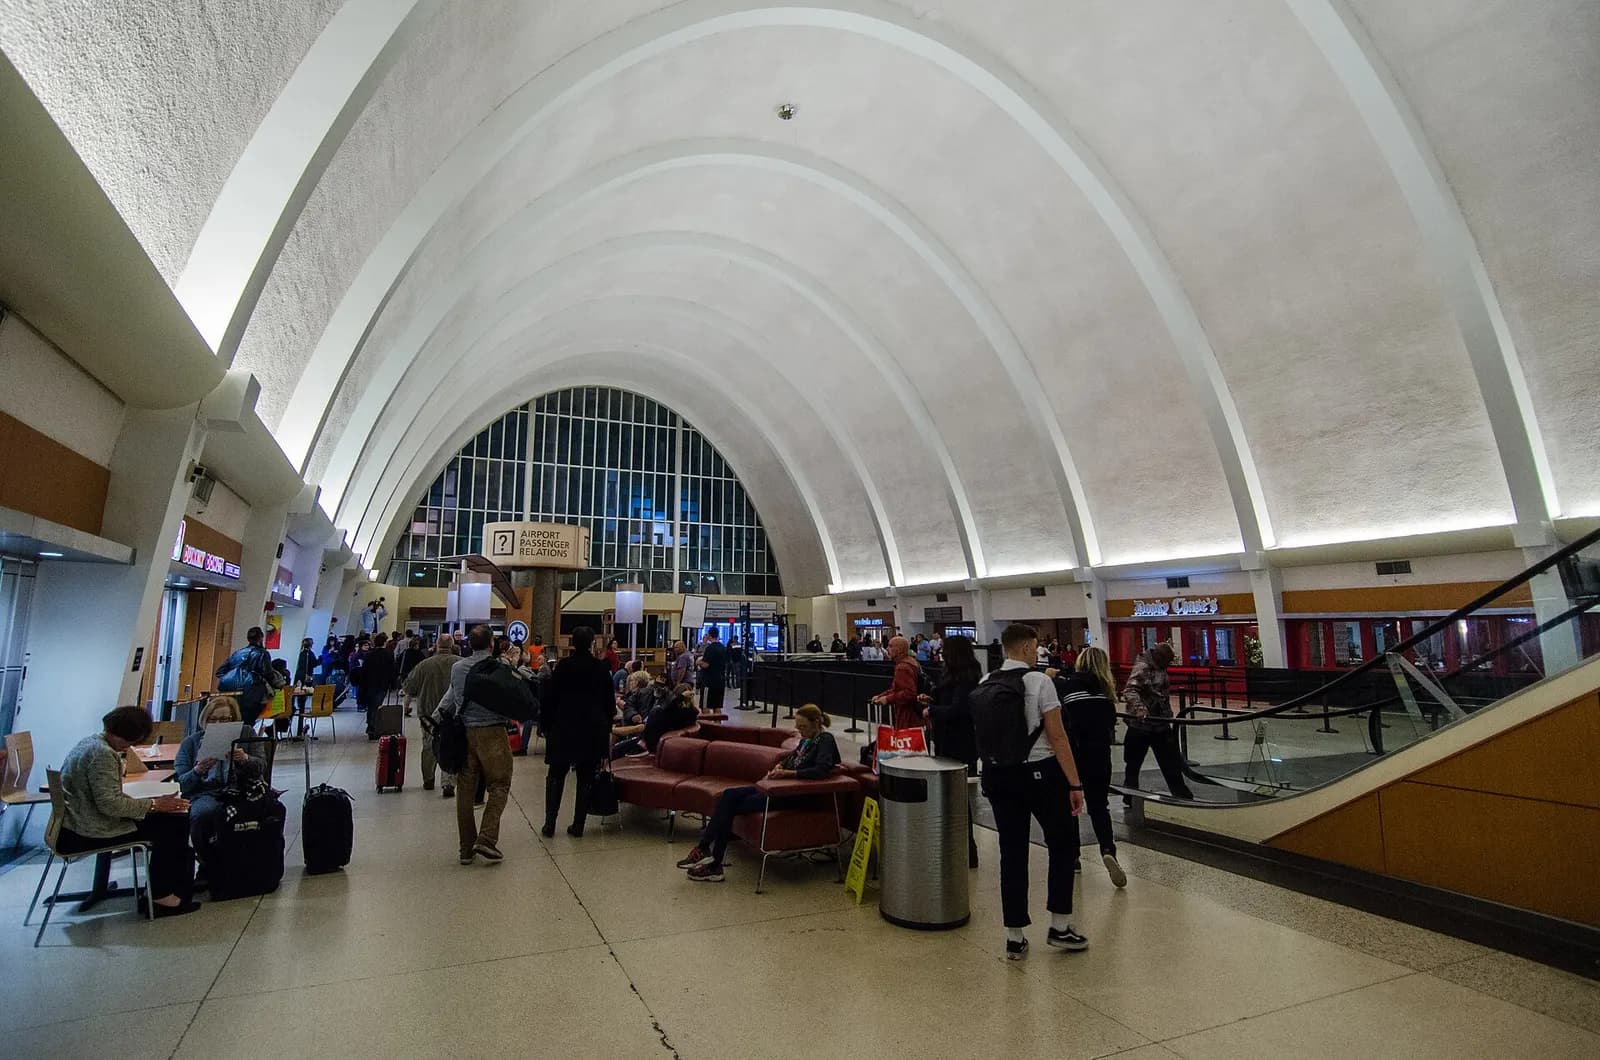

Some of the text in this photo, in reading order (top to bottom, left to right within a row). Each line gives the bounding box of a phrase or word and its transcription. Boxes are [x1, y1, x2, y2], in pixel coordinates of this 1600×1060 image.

[520, 530, 561, 539] AIRPORT
[519, 539, 570, 549] PASSENGER
[519, 548, 568, 558] RELATIONS
[890, 735, 913, 749] HOT
